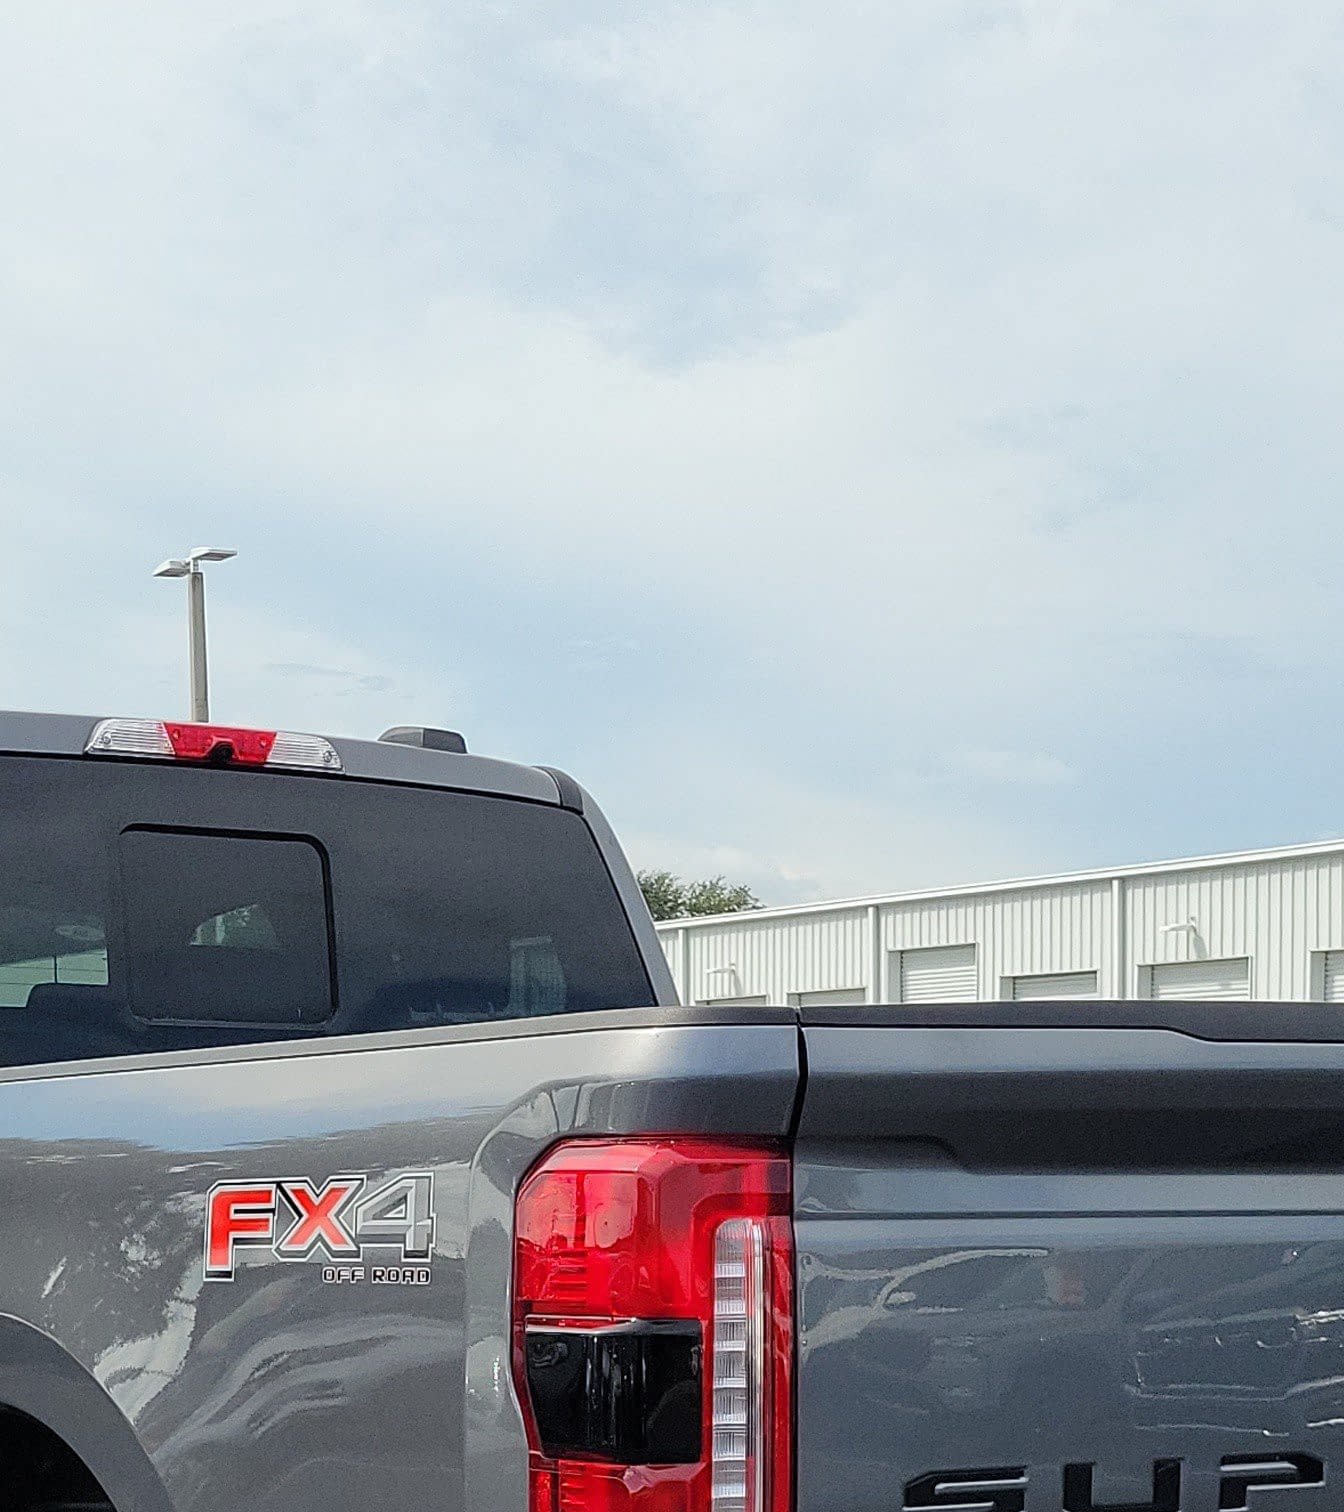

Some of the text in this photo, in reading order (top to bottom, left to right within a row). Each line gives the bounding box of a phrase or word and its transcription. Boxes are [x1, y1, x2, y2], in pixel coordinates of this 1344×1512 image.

[203, 1172, 436, 1282] FX4
[322, 1266, 431, 1285] OFF ROAD
